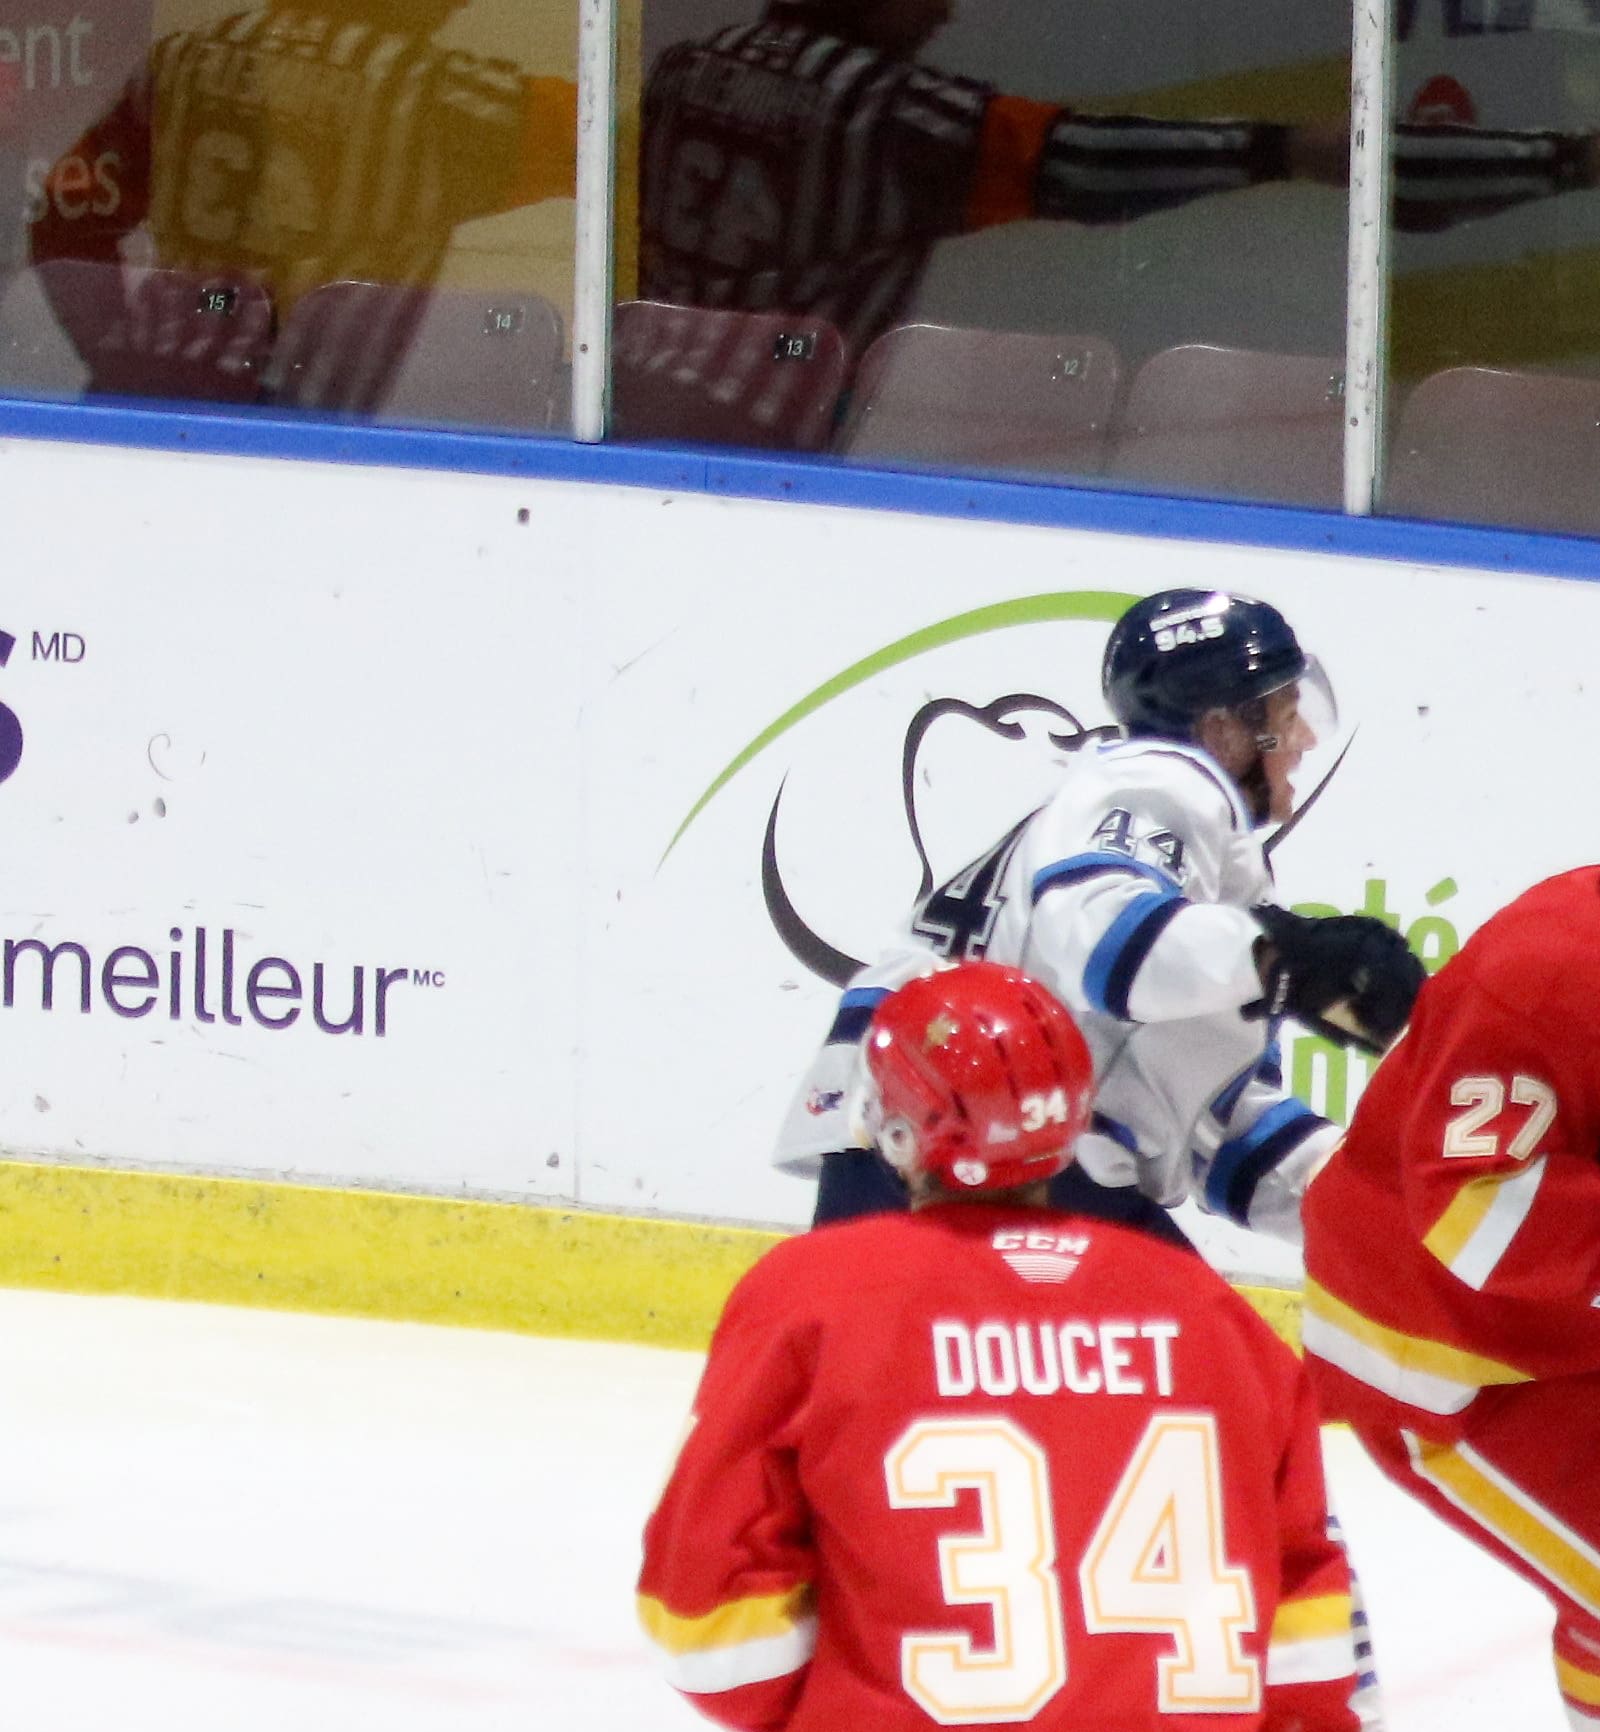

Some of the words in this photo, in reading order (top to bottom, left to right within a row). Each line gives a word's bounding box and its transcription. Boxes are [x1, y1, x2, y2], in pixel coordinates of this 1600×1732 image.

[208, 294, 225, 311] 15
[496, 313, 511, 329] 14
[786, 339, 803, 356] 13
[30, 632, 86, 664] MD
[2, 926, 408, 1038] meilleur
[412, 968, 446, 988] MC
[1019, 1096, 1068, 1133] 34
[1442, 1076, 1558, 1162] 27
[991, 1230, 1090, 1256] CCM
[931, 1321, 1180, 1398] DOUCET
[883, 1413, 1262, 1727] 34
